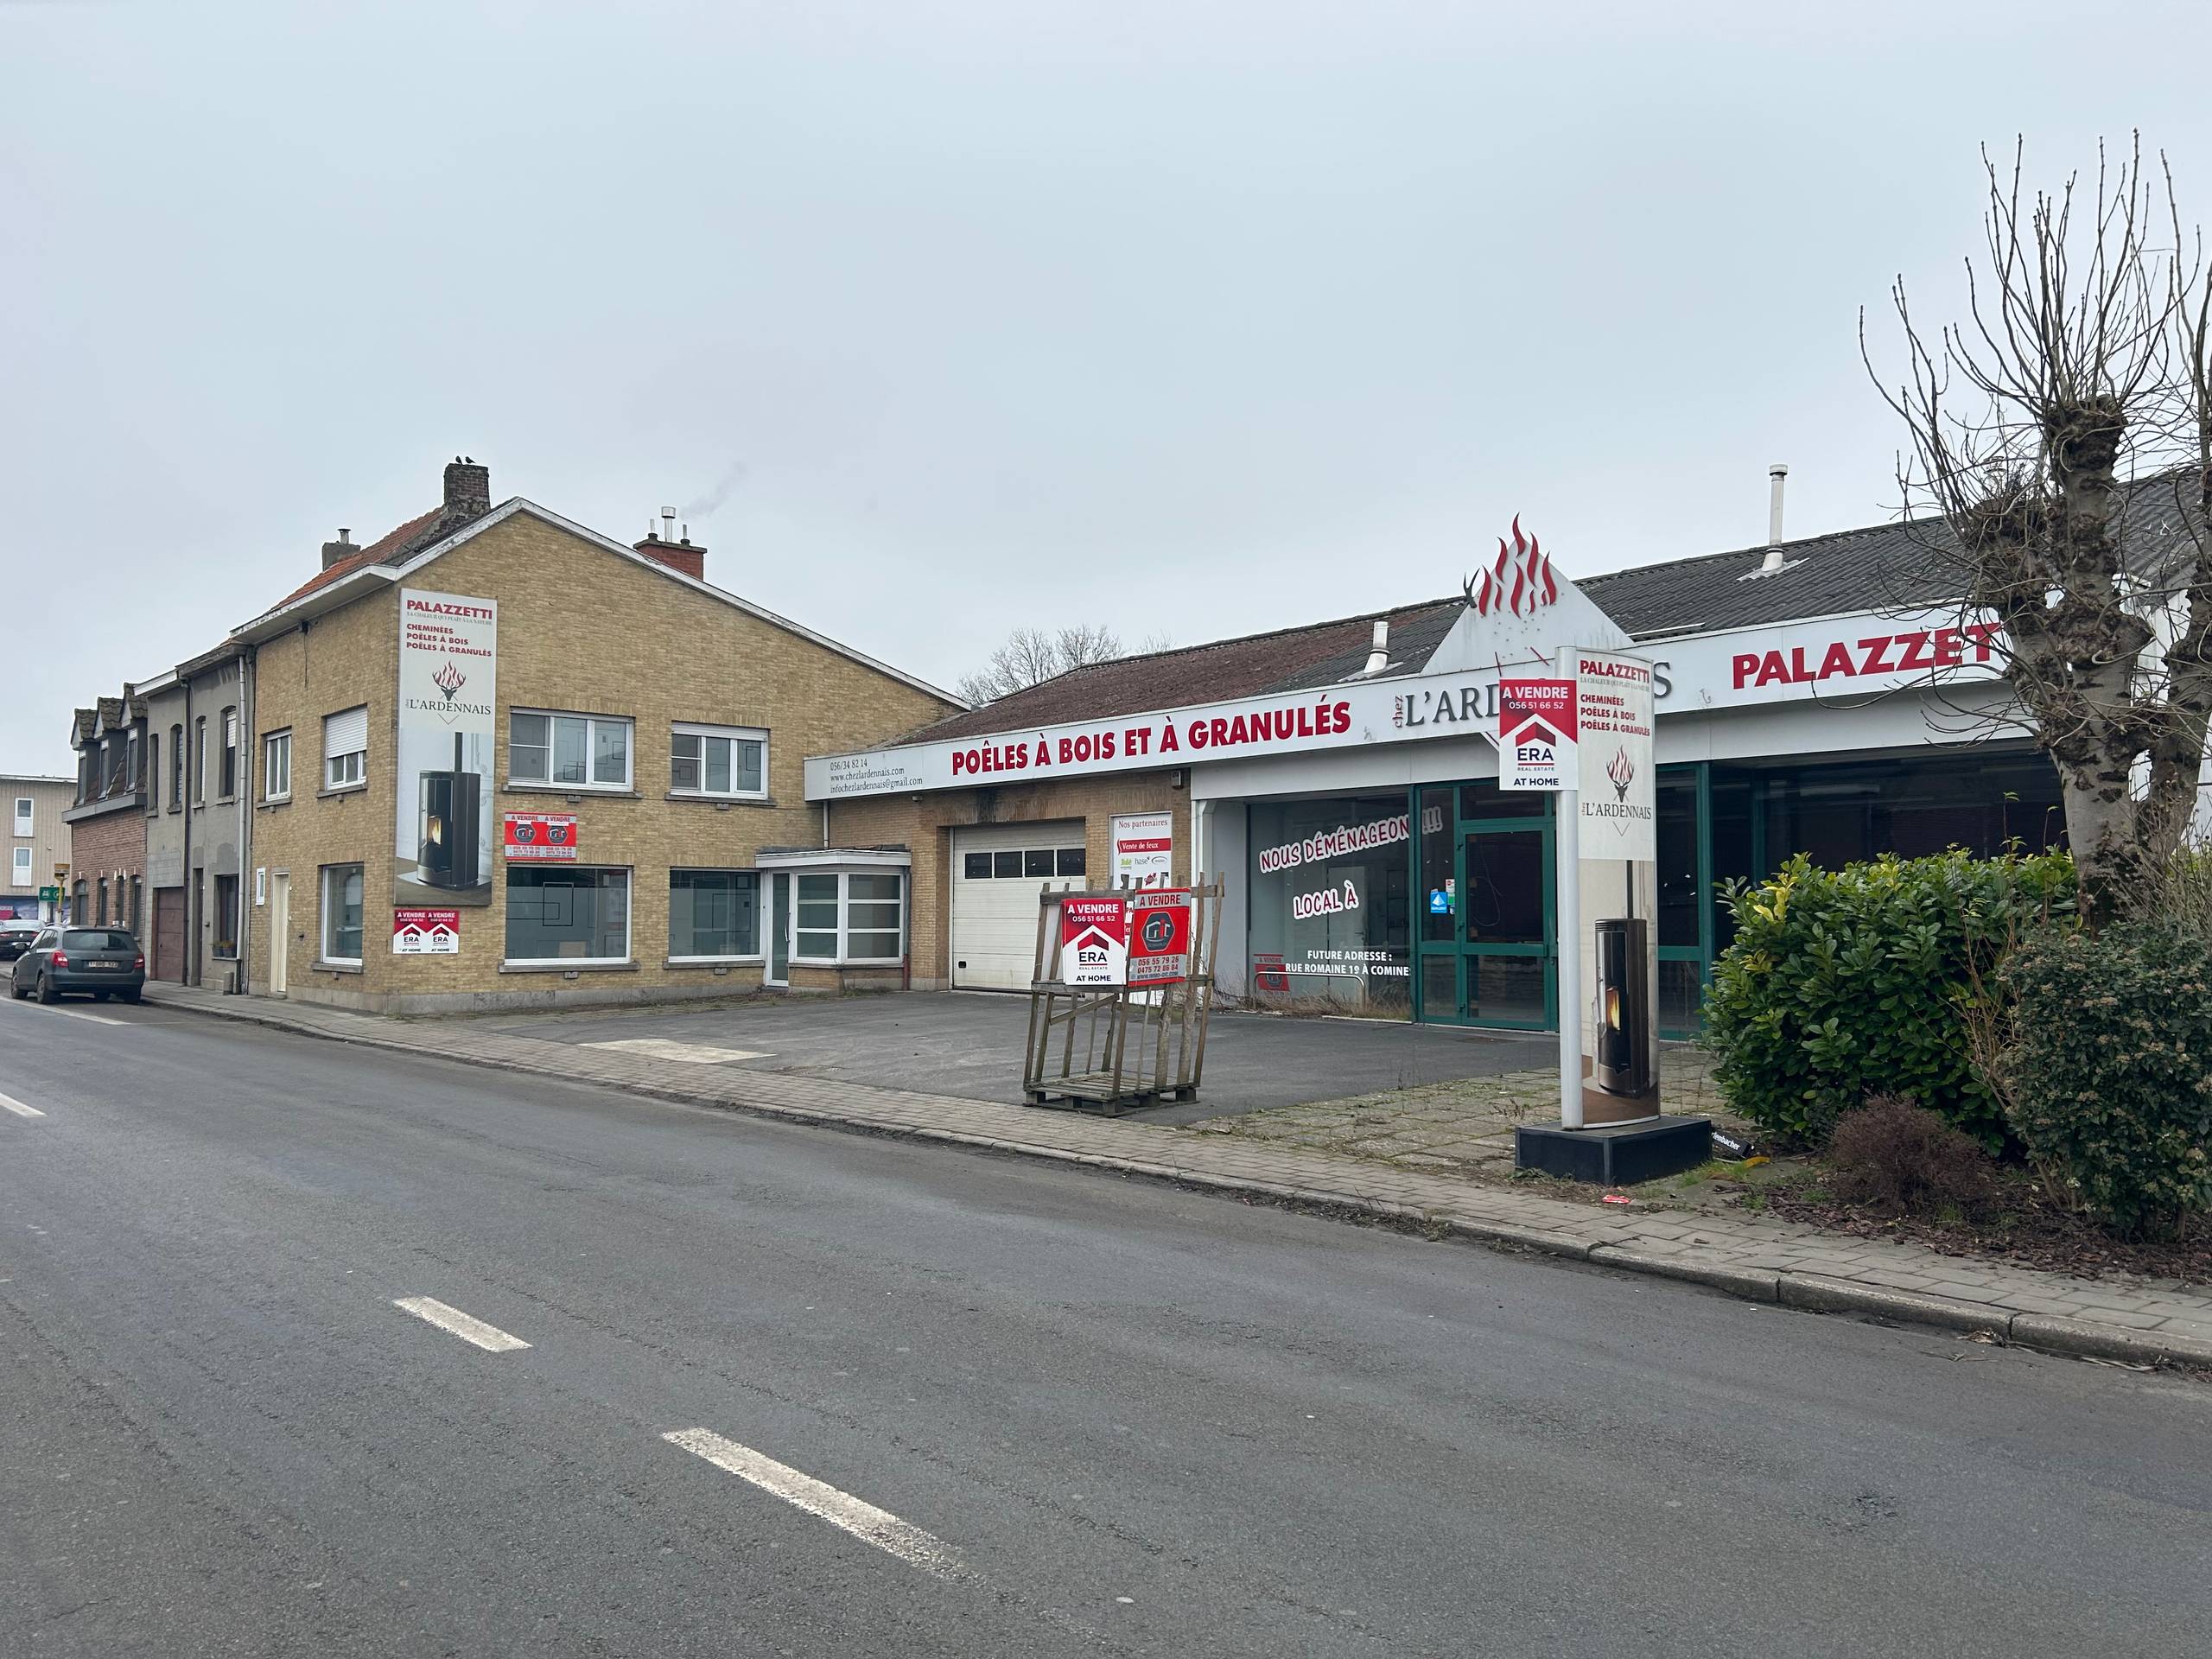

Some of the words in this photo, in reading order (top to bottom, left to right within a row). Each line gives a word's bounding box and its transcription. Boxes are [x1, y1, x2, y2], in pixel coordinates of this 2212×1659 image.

[407, 600, 493, 620] PALAZZETTI
[407, 624, 454, 634] CHEMINÉES
[407, 632, 437, 642] POÊLES
[407, 641, 437, 651] POÊLES
[440, 644, 446, 652] À
[448, 646, 492, 657] GRANULÉS
[1732, 622, 2002, 690] PALAZZET
[1580, 659, 1649, 683] PALAZZETTI
[1502, 687, 1512, 699] A
[1515, 687, 1568, 699] VENDRE
[1580, 694, 1624, 706] CHEMINÉES
[410, 699, 491, 715] L'ARDENNAIS
[1392, 695, 1403, 728] chez
[1580, 706, 1610, 718] POÊLES
[1612, 708, 1618, 719] À
[1620, 711, 1636, 721] BOIS
[952, 741, 1027, 776] POÊLES
[1035, 732, 1052, 767] À
[1059, 731, 1116, 764] BOIS
[1125, 728, 1152, 756] ET
[1160, 715, 1179, 753] À
[1188, 694, 1351, 749] GRANULÉS
[1580, 720, 1610, 731] POÊLES
[1612, 721, 1618, 732] À
[1620, 724, 1650, 736] GRANULÉS
[1517, 748, 1554, 760] ERA
[830, 760, 850, 772] 056/34
[852, 760, 859, 768] 82
[861, 759, 868, 767] 14
[830, 767, 905, 782] www.chezlardennais.com
[830, 777, 923, 794] infochezlardennais@gmail.com
[1586, 803, 1651, 820] L'ARDENNAIS
[1132, 819, 1168, 830] partenaires
[1261, 842, 1300, 872] NOUS
[1305, 817, 1410, 860] DÉMÉNAGEON
[1140, 896, 1145, 906] A
[1147, 894, 1181, 906] VENDRE
[1295, 890, 1341, 918] LOCAL
[1345, 881, 1357, 906] À
[1067, 904, 1075, 913] A
[1077, 904, 1119, 913] VENDRE
[1079, 952, 1108, 963] ERA
[1307, 950, 1343, 960] FUTURE
[1344, 951, 1386, 962] ADRESSE
[1286, 963, 1302, 973] RUE
[1305, 963, 1346, 974] ROMAINE
[1349, 965, 1359, 975] 19
[1362, 963, 1369, 975] À
